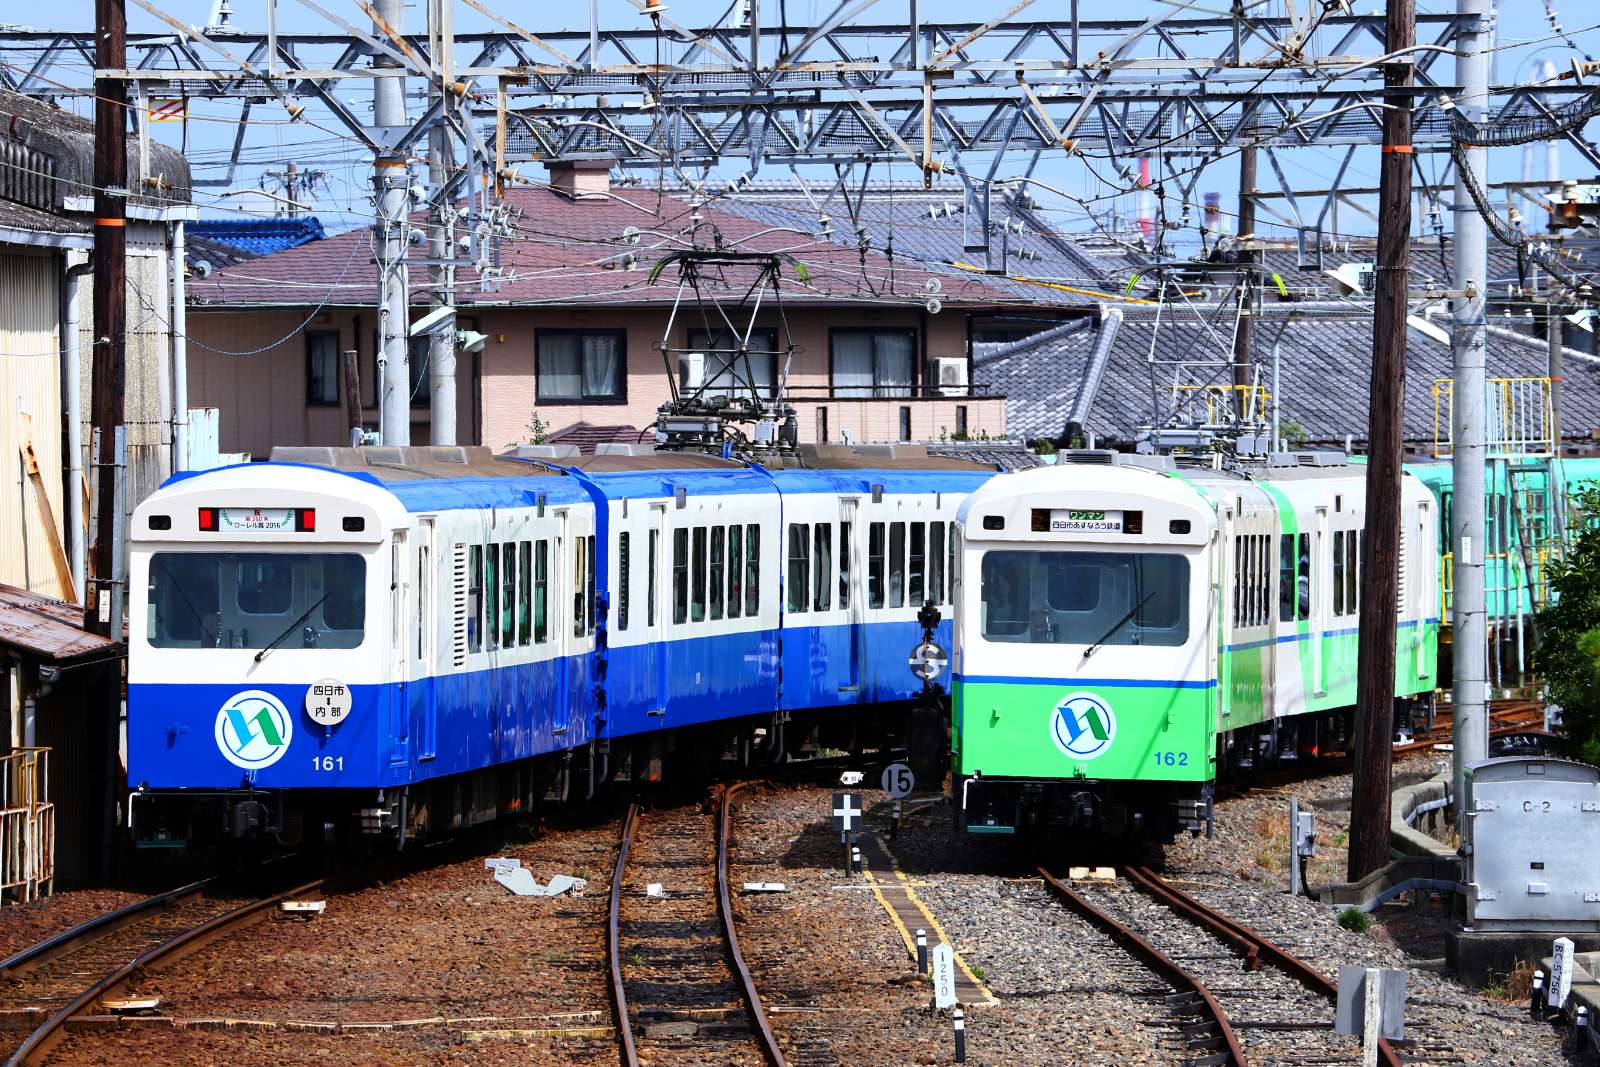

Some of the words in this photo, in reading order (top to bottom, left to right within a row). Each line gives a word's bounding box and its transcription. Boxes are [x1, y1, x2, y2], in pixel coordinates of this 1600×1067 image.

[1070, 511, 1104, 520] ワンマン
[313, 685, 345, 696] 四日市
[312, 755, 344, 771] 161
[1154, 751, 1188, 766] 162
[887, 769, 911, 793] 15
[1523, 800, 1551, 813] C-2
[940, 951, 949, 997] 1250
